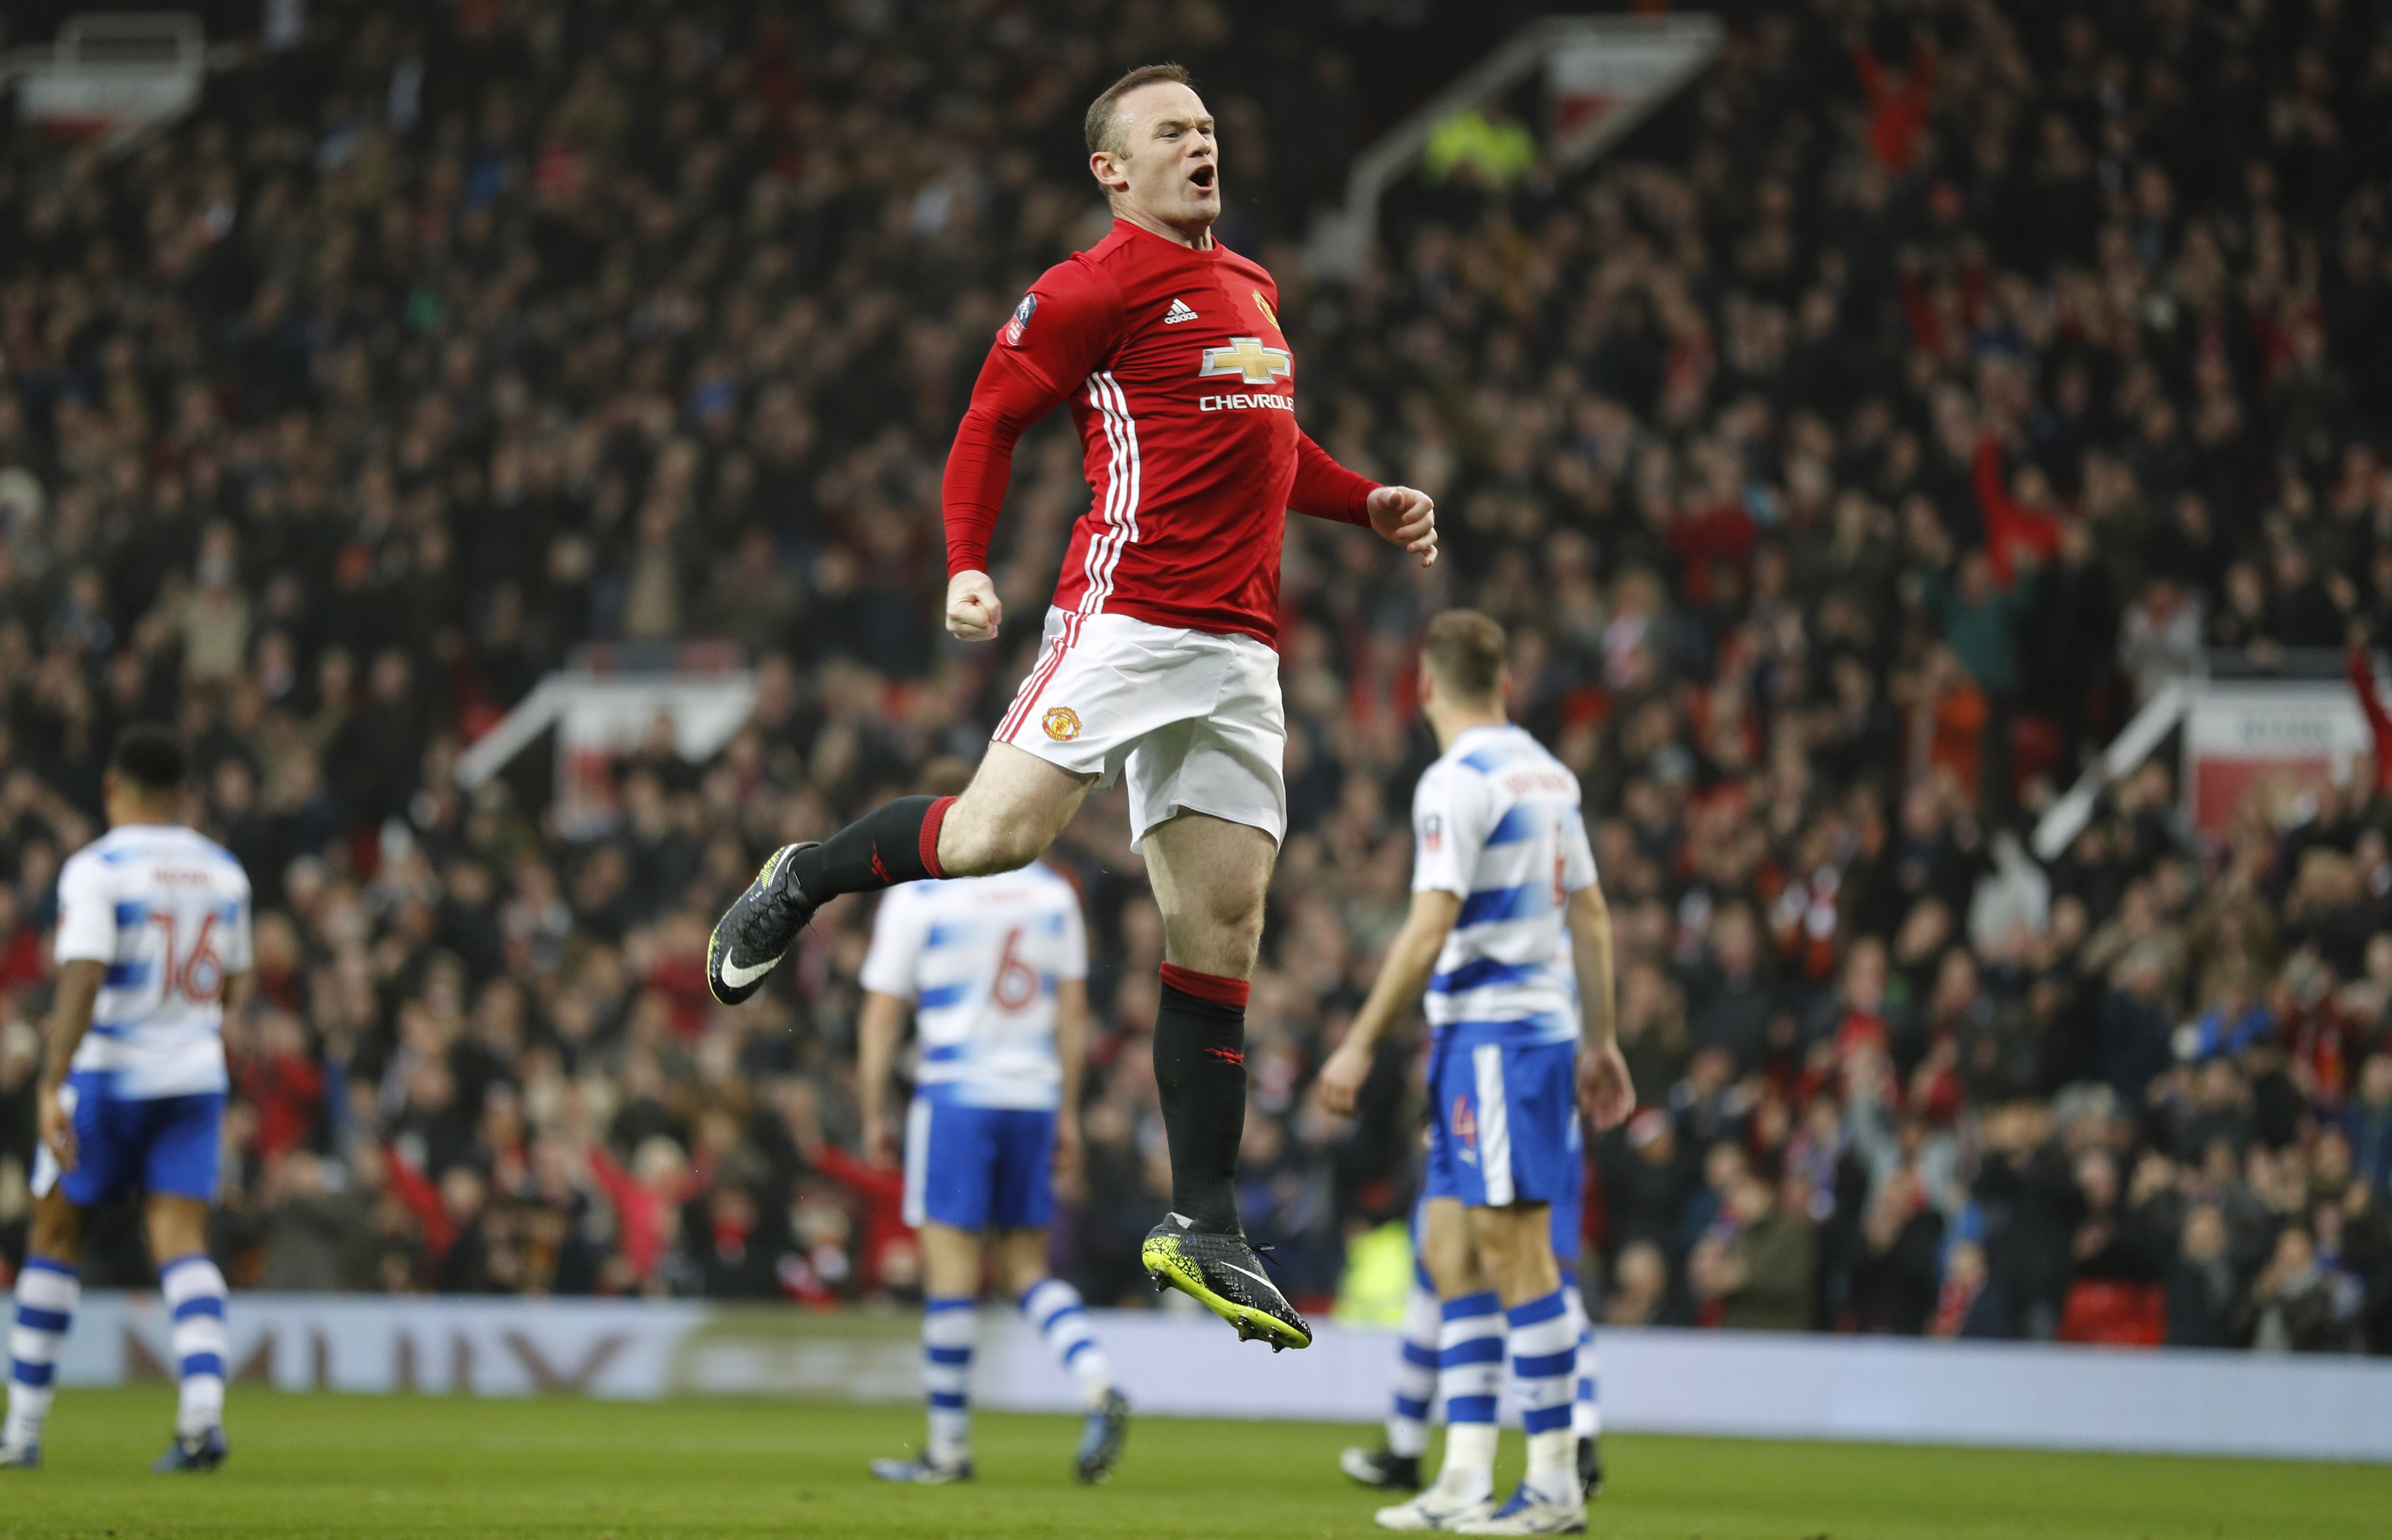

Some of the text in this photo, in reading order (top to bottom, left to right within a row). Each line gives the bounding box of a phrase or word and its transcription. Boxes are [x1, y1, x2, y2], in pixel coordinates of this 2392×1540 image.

[1164, 312, 1198, 324] adidas
[150, 910, 224, 1005] 16
[992, 926, 1039, 1013] 6
[1451, 1094, 1477, 1148] 4
